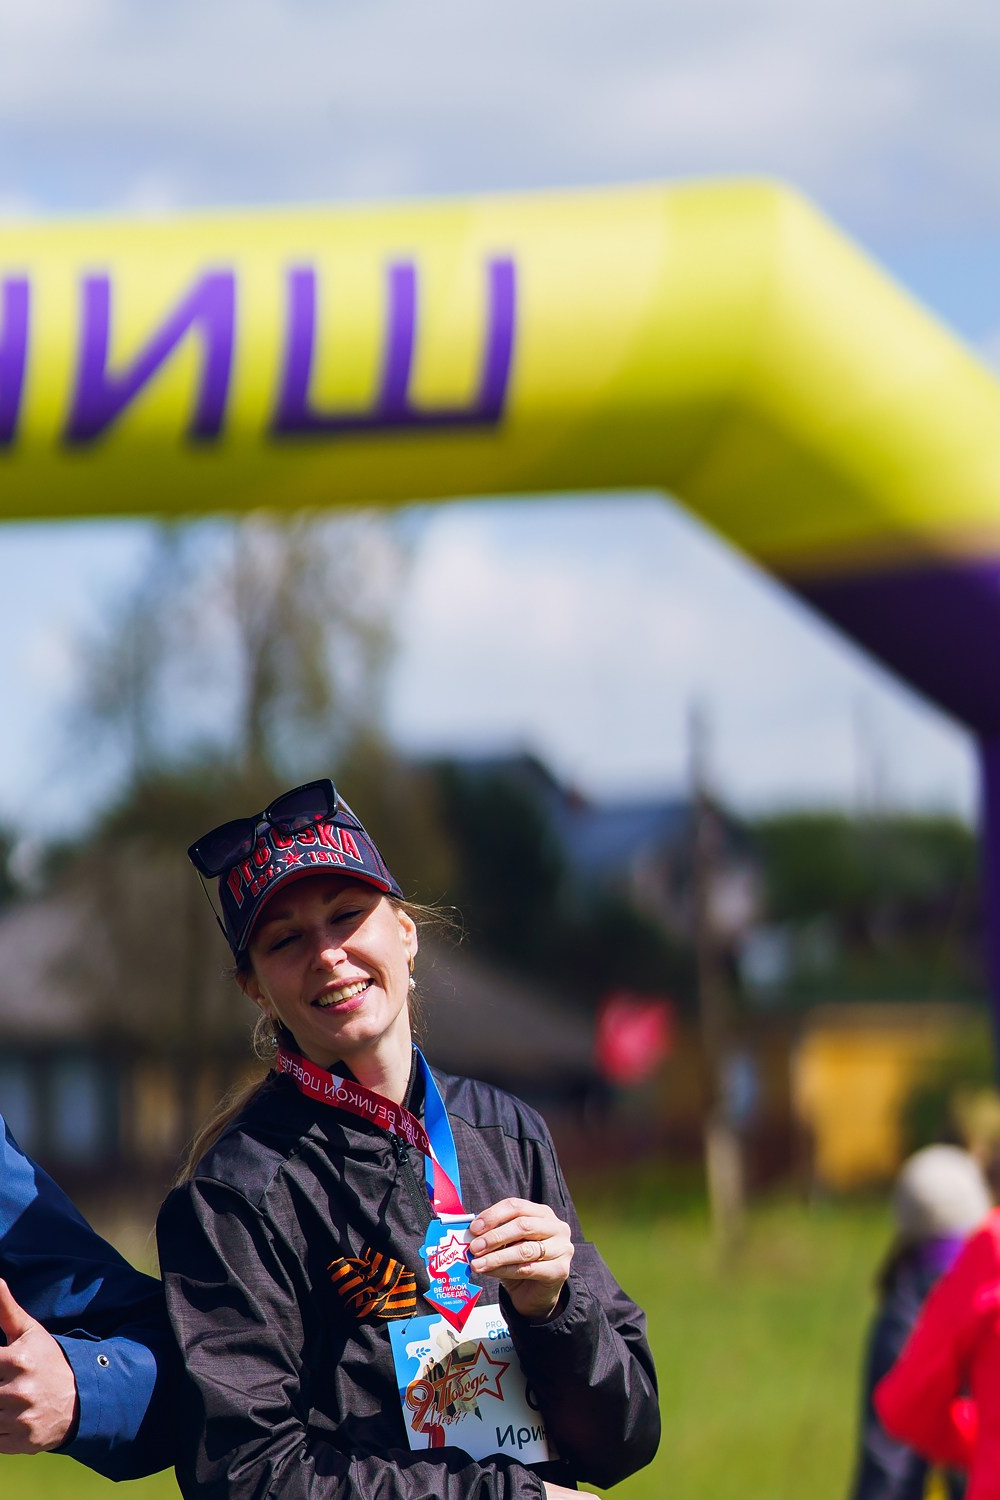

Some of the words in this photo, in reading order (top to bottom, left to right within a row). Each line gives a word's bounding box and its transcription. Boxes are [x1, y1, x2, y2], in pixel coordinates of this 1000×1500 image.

[307, 851, 346, 865] 1911
[324, 1082, 396, 1124] ВЕЛИКОЙ
[433, 1283, 468, 1294] ВЕЛИКОЙ
[485, 1320, 502, 1329] PRO
[431, 1362, 489, 1413] Победа
[405, 1379, 436, 1432] 9
